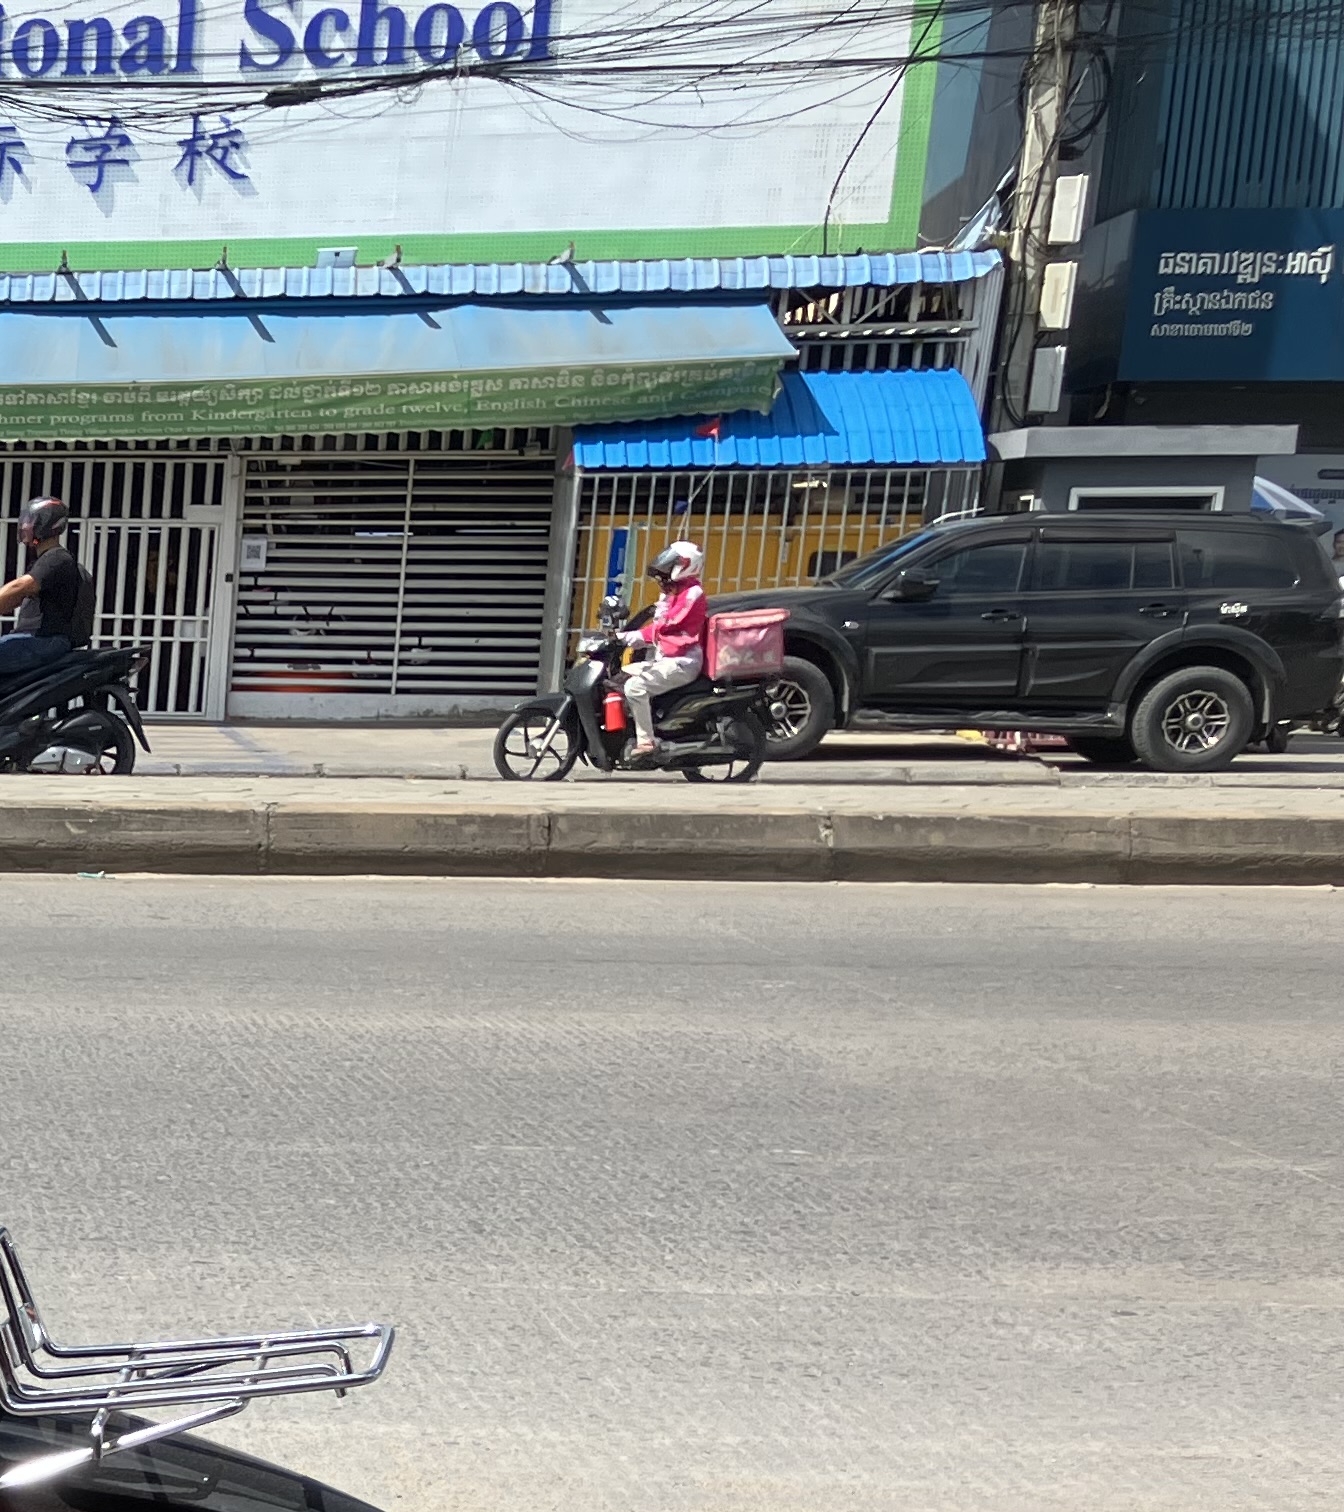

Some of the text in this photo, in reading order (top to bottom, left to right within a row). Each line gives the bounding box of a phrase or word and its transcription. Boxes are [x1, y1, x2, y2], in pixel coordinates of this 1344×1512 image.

[239, 0, 555, 71] School
[49, 412, 135, 427] programs
[141, 411, 185, 423] from
[192, 407, 313, 422] Kindergarten
[319, 406, 338, 418] to
[344, 405, 395, 420] grade
[475, 397, 548, 414] English
[554, 393, 634, 409] Chinese
[643, 390, 673, 404] and
